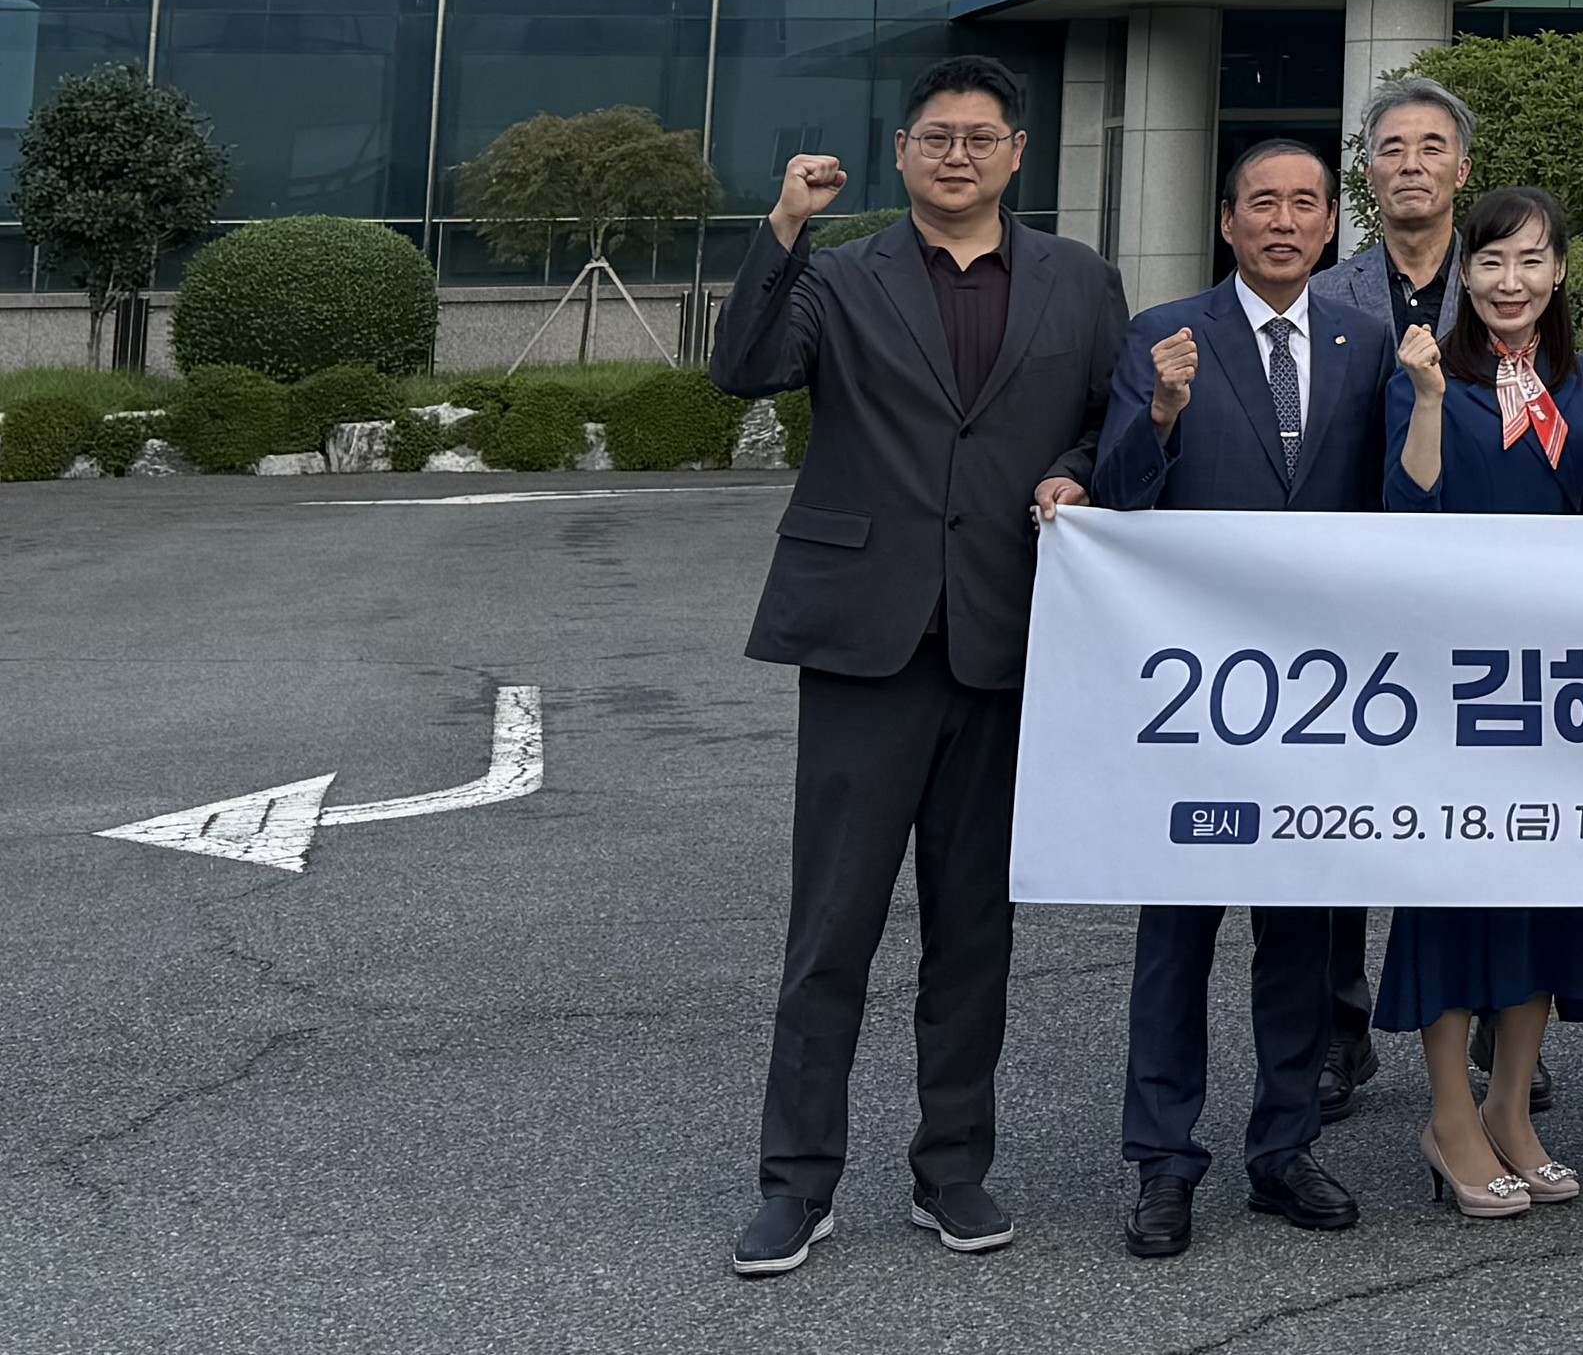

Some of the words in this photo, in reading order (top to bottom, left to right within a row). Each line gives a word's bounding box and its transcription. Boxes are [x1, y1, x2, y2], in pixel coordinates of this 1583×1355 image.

[1136, 647, 1418, 746] 2026
[1192, 809, 1240, 837] 일시
[1271, 804, 1382, 840] 2026.
[1392, 805, 1426, 840] 9.
[1440, 805, 1495, 840] 18.
[1505, 802, 1560, 843] (금)
